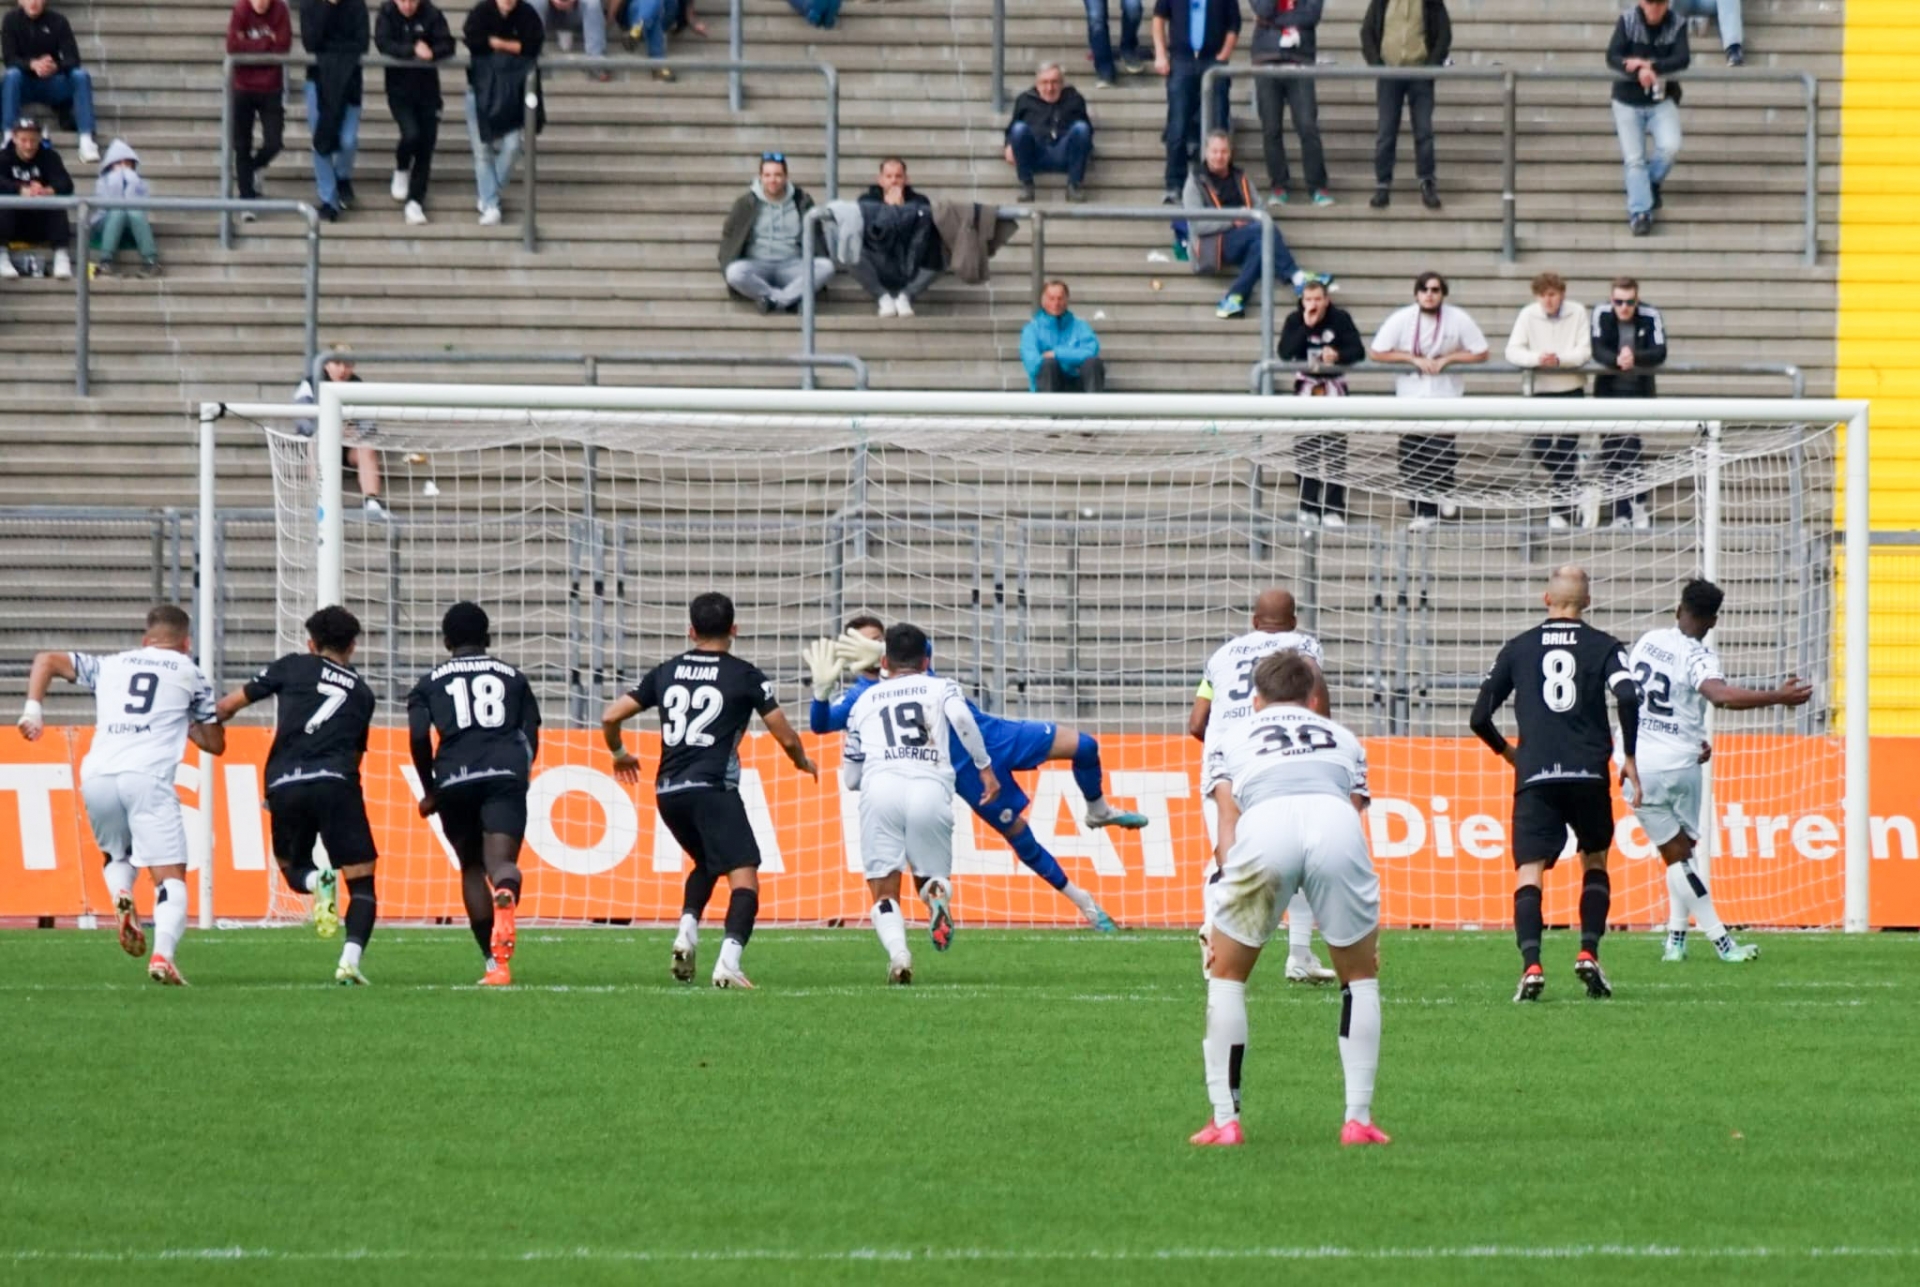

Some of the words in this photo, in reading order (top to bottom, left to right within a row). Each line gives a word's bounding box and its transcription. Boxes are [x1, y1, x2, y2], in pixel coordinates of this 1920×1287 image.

[1541, 631, 1577, 645] BRILL
[124, 672, 159, 714] 9
[674, 665, 719, 681] NAJJAR
[872, 686, 928, 703] FREIBERG
[1542, 649, 1577, 713] 8
[304, 682, 348, 735] 7
[445, 674, 505, 729] 18
[663, 685, 724, 747] 32
[879, 701, 929, 747] 19
[885, 746, 939, 762] ALBERICO
[1367, 796, 1504, 860] Die
